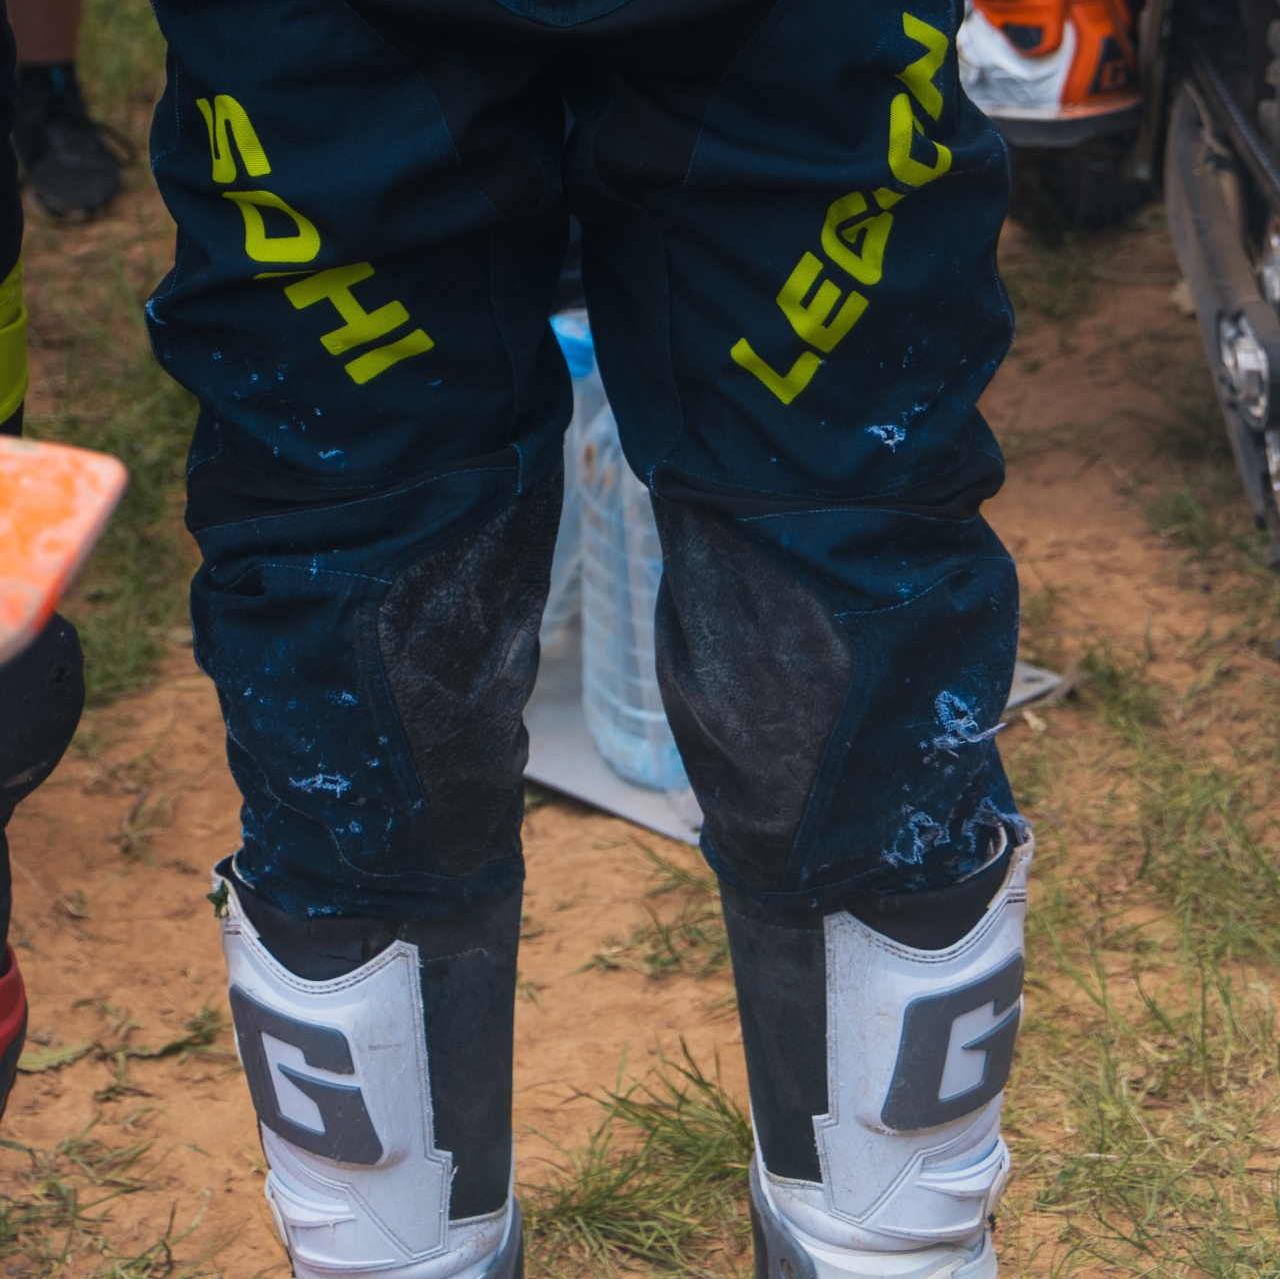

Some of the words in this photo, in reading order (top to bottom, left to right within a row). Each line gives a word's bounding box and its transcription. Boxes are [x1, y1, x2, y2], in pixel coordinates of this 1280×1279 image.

[195, 94, 435, 385] SOHI
[228, 984, 384, 1168] G
[879, 956, 1025, 1133] G
